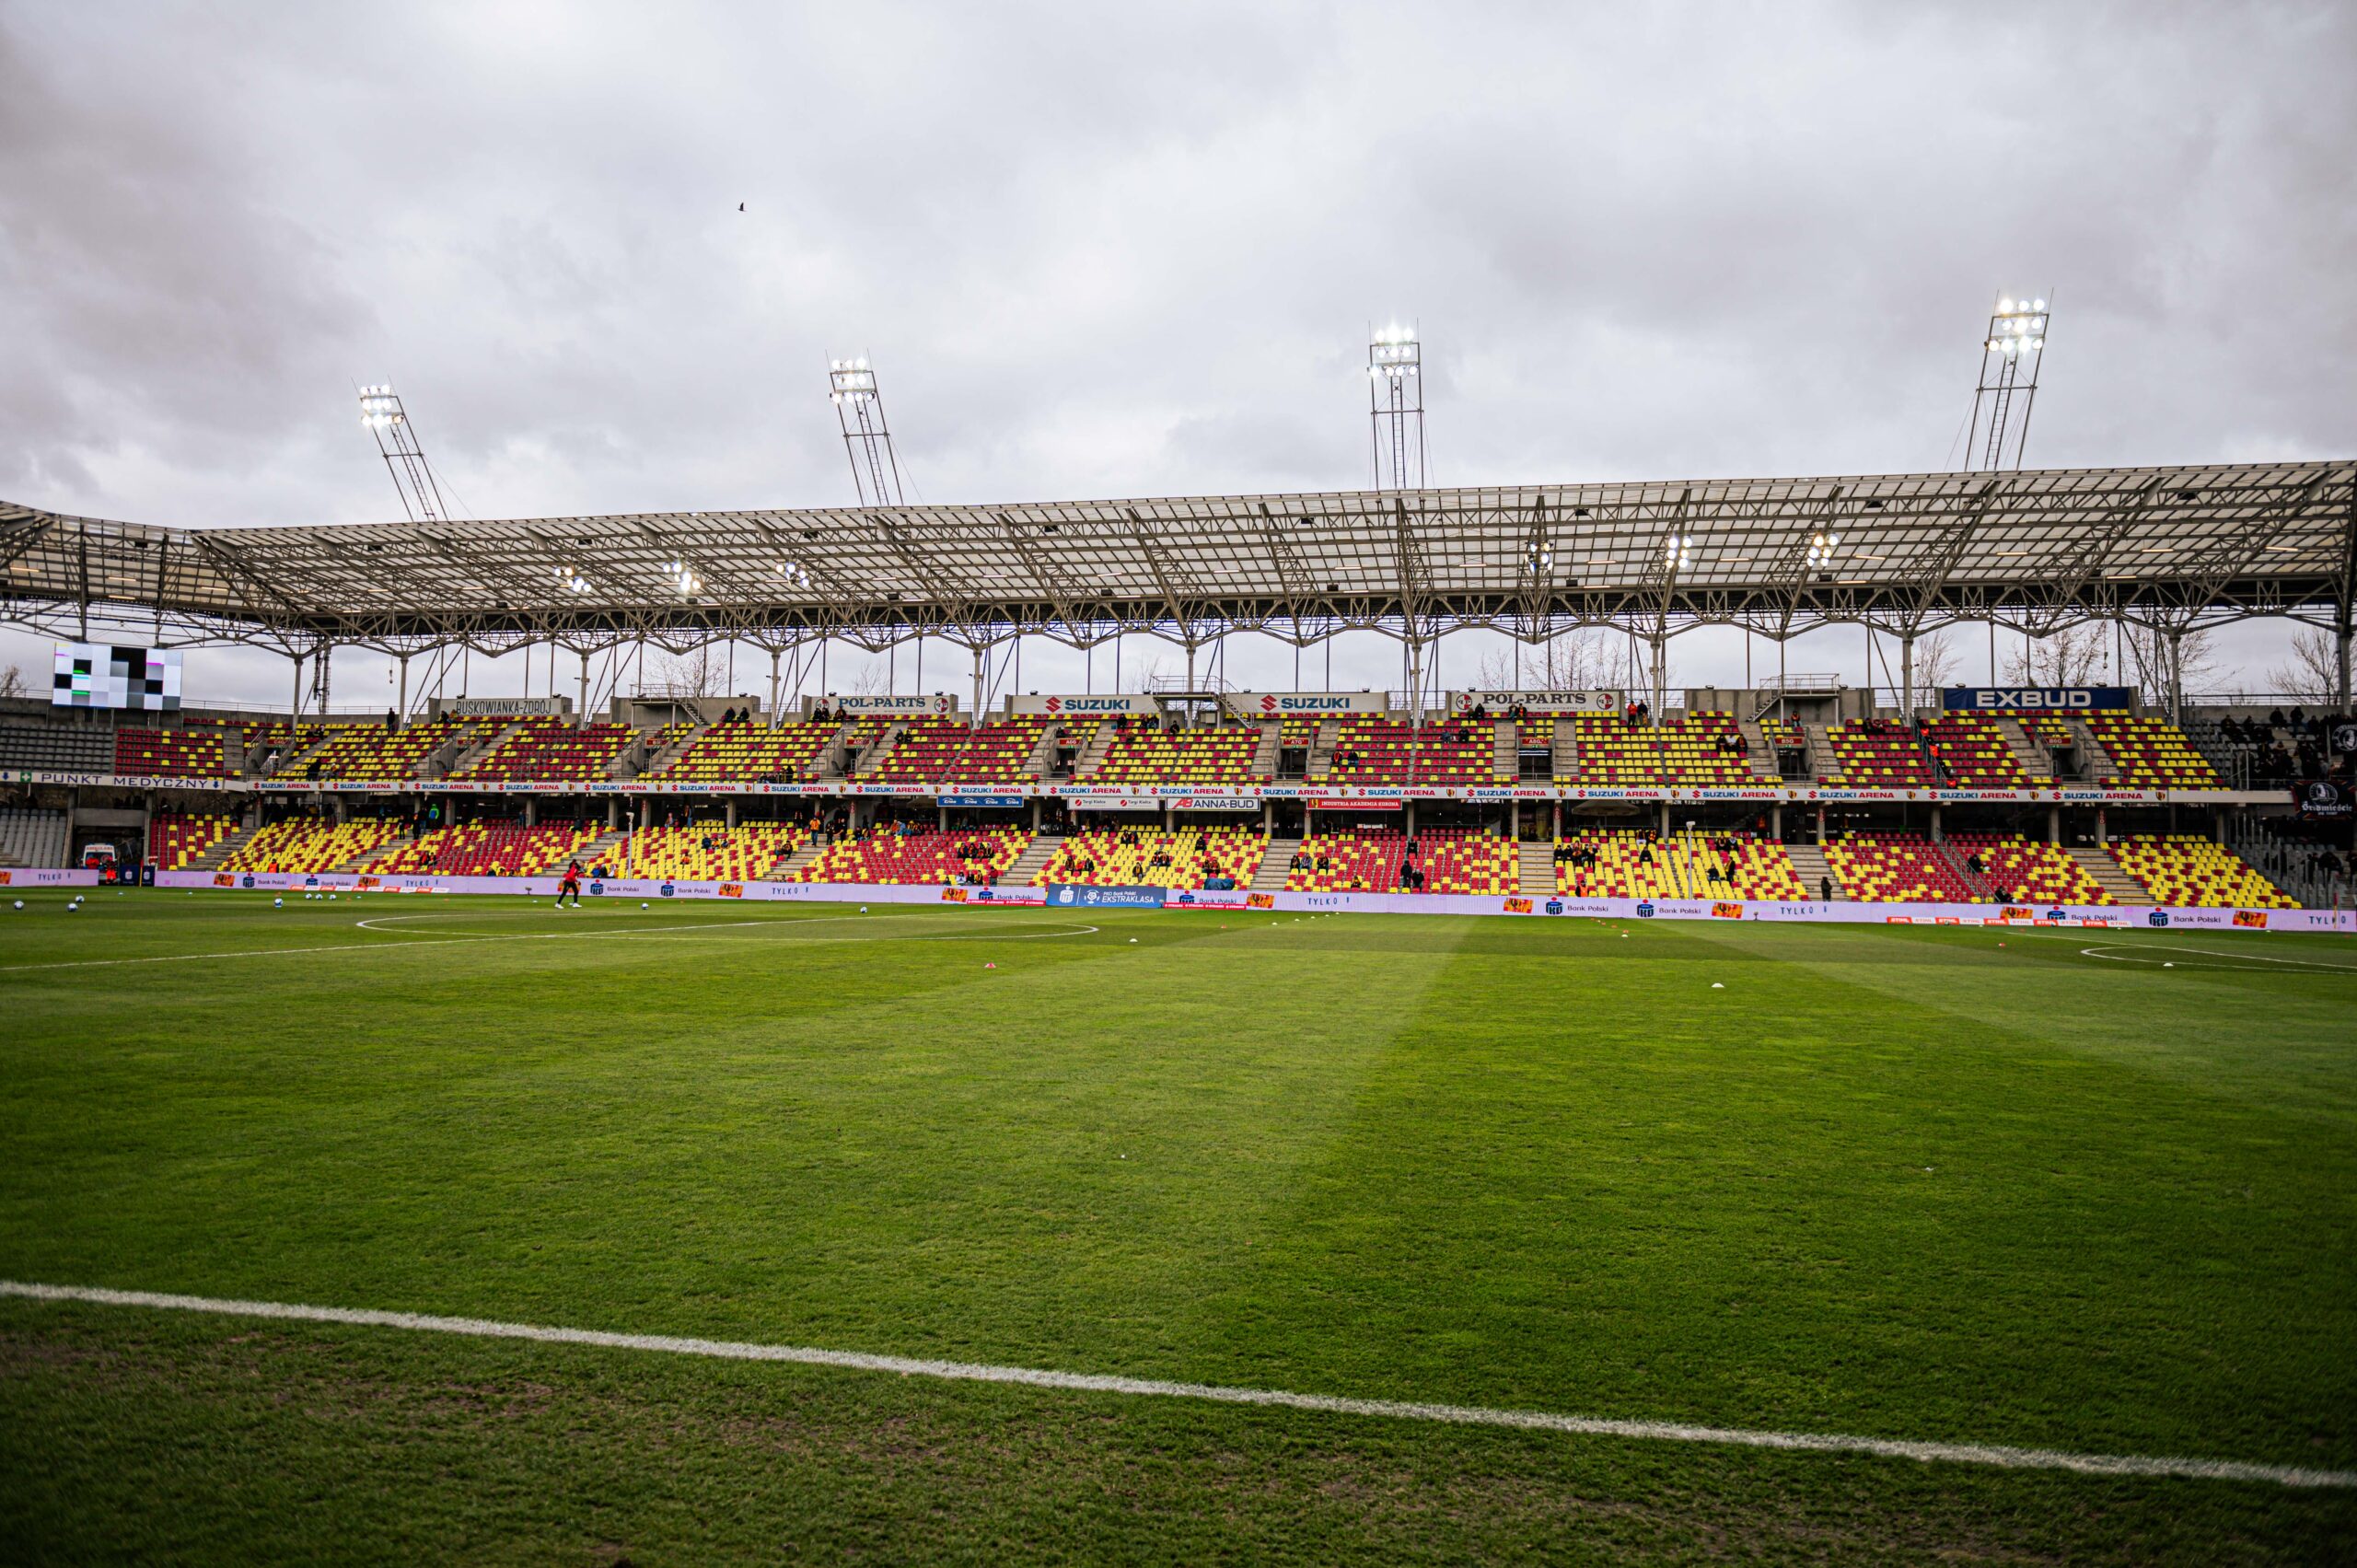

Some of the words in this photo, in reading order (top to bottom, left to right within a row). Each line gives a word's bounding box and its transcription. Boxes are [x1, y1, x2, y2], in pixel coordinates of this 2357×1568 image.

[838, 697, 925, 708] POL-PARTS
[1281, 697, 1350, 709] SUZUKI
[1482, 693, 1586, 704] POL-PARTS
[1976, 691, 2092, 707] EXBUD
[456, 699, 552, 714] BUSKOWIANKA-ZDRÓJ
[1064, 699, 1131, 710] SUZUKI
[41, 773, 102, 784] PUNKT
[113, 777, 208, 789] MEDYCZNY
[1101, 895, 1155, 904] EKSTRAKLASA
